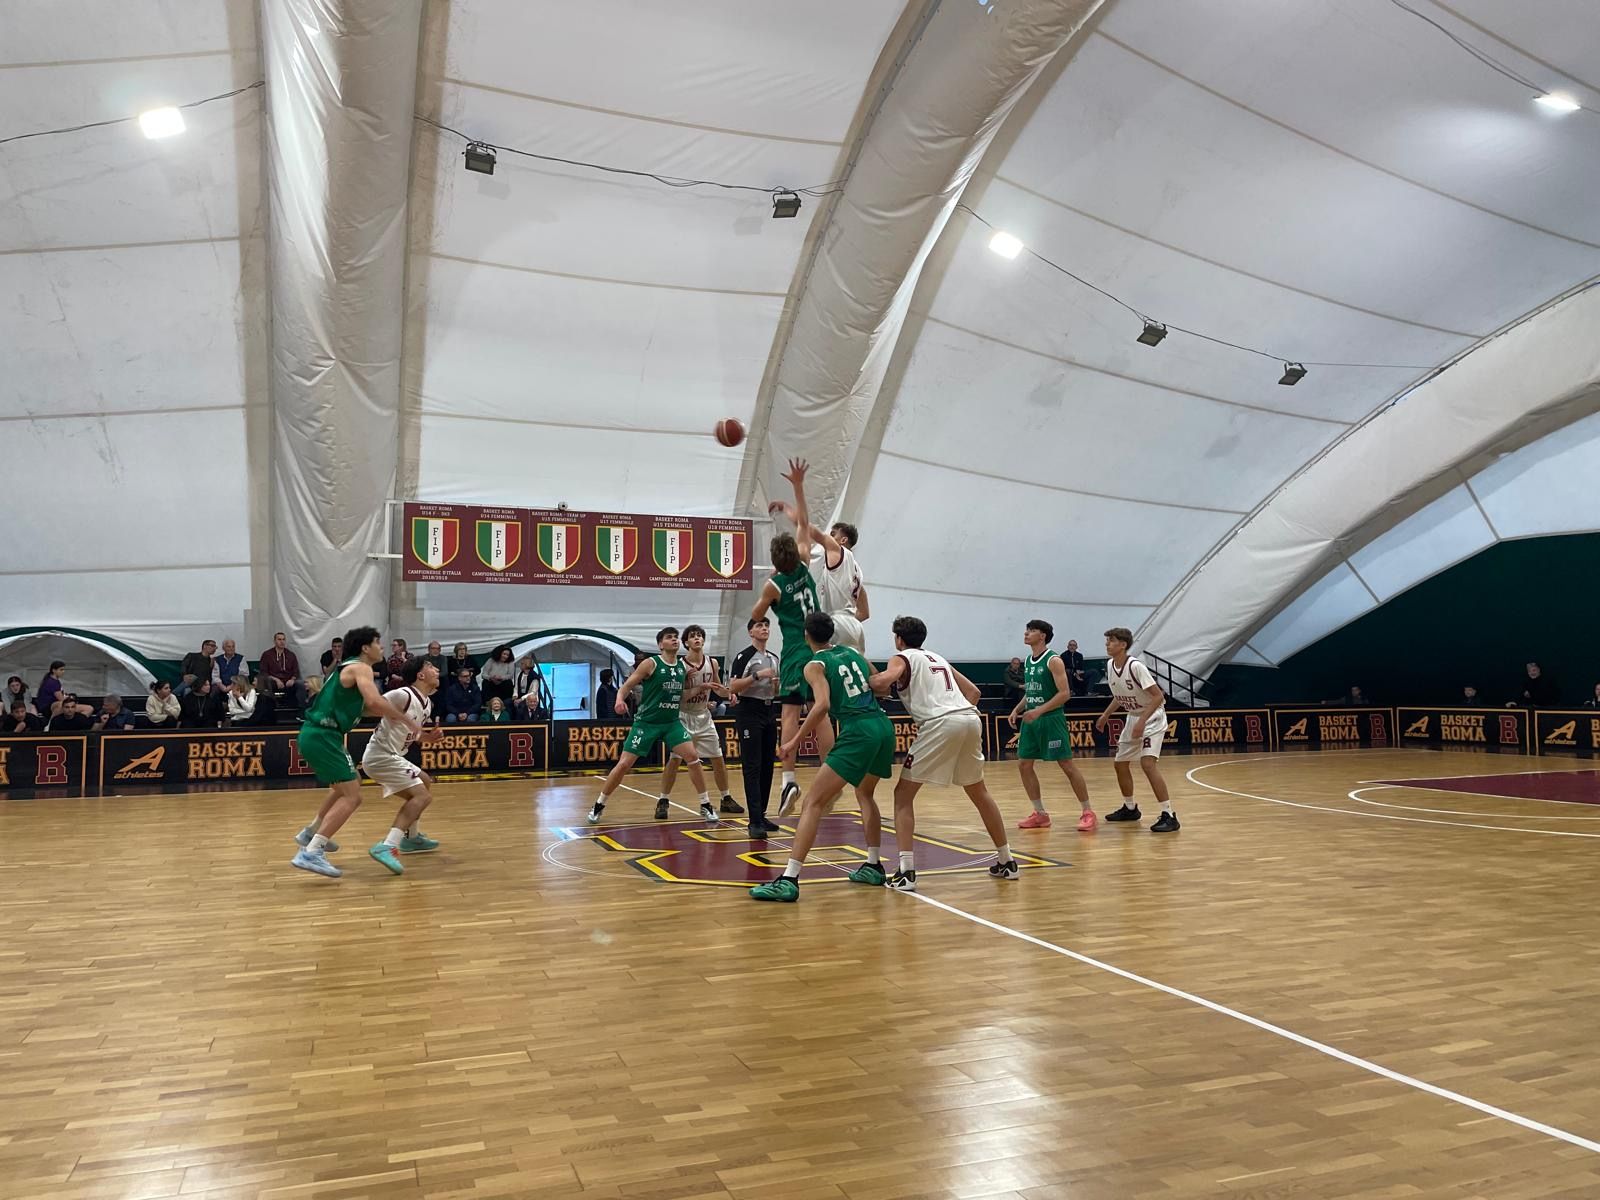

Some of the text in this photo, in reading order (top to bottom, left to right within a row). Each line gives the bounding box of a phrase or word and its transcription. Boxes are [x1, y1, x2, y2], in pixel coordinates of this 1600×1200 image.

[793, 587, 815, 620] 73
[838, 661, 871, 698] 21
[929, 666, 953, 691] 7
[1126, 680, 1134, 690] 5
[1189, 717, 1233, 728] BASKET
[1245, 715, 1263, 742] B
[1319, 715, 1358, 726] BASKET
[1369, 714, 1387, 740] B
[1440, 714, 1485, 727] BASKET
[568, 726, 632, 741] BASKE
[895, 723, 918, 735] BAS
[1191, 727, 1235, 743] ROMA
[1320, 726, 1360, 741] ROMA
[1441, 726, 1486, 742] ROMA
[1500, 715, 1519, 744] B
[421, 735, 489, 749] BASKET
[632, 735, 642, 745] 34
[1070, 732, 1095, 747] MA
[188, 740, 266, 757] BASKET
[508, 732, 534, 767] B
[567, 741, 619, 762] ROM
[35, 746, 68, 784] B
[421, 749, 489, 769] ROMA
[113, 771, 165, 779] athletes
[188, 757, 266, 778] ROMA
